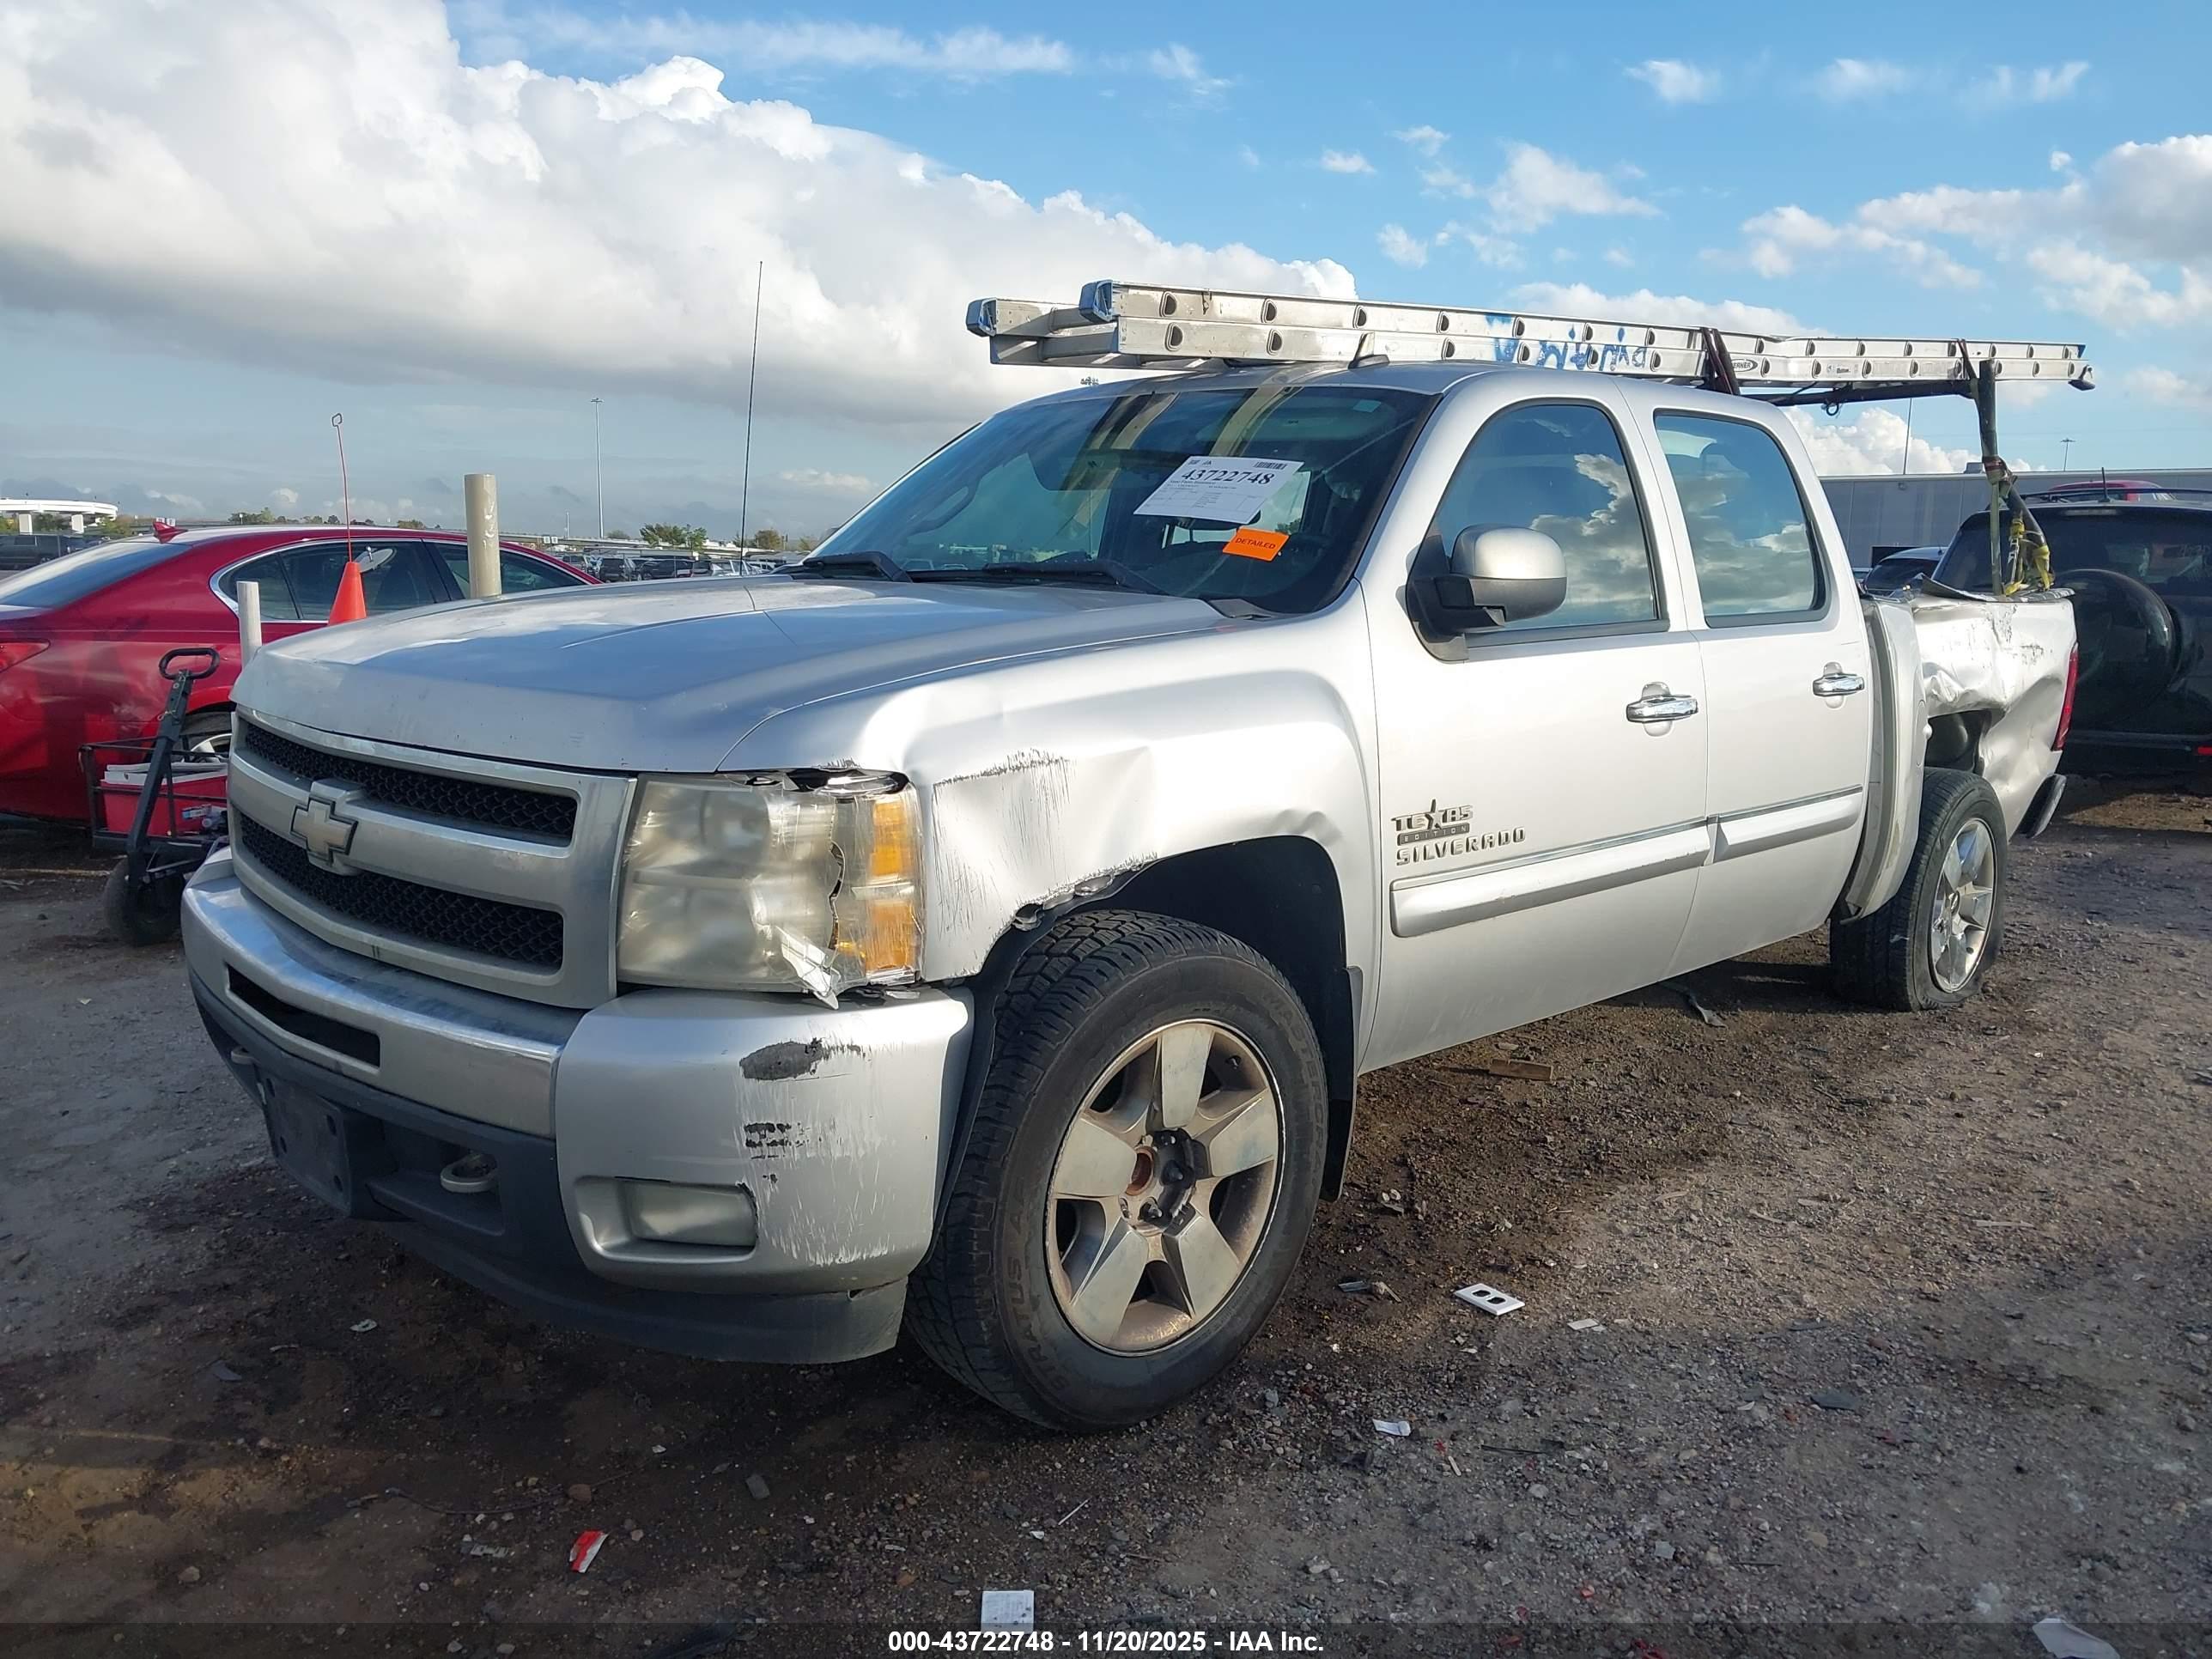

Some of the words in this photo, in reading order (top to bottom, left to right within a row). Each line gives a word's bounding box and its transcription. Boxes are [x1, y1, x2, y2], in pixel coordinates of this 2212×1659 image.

[1182, 469, 1275, 484] 43722748
[1235, 537, 1276, 550] DETAILED
[1391, 799, 1474, 831] TEXAS
[1403, 825, 1468, 842] EDITION
[1396, 827, 1526, 866] SILVERADO
